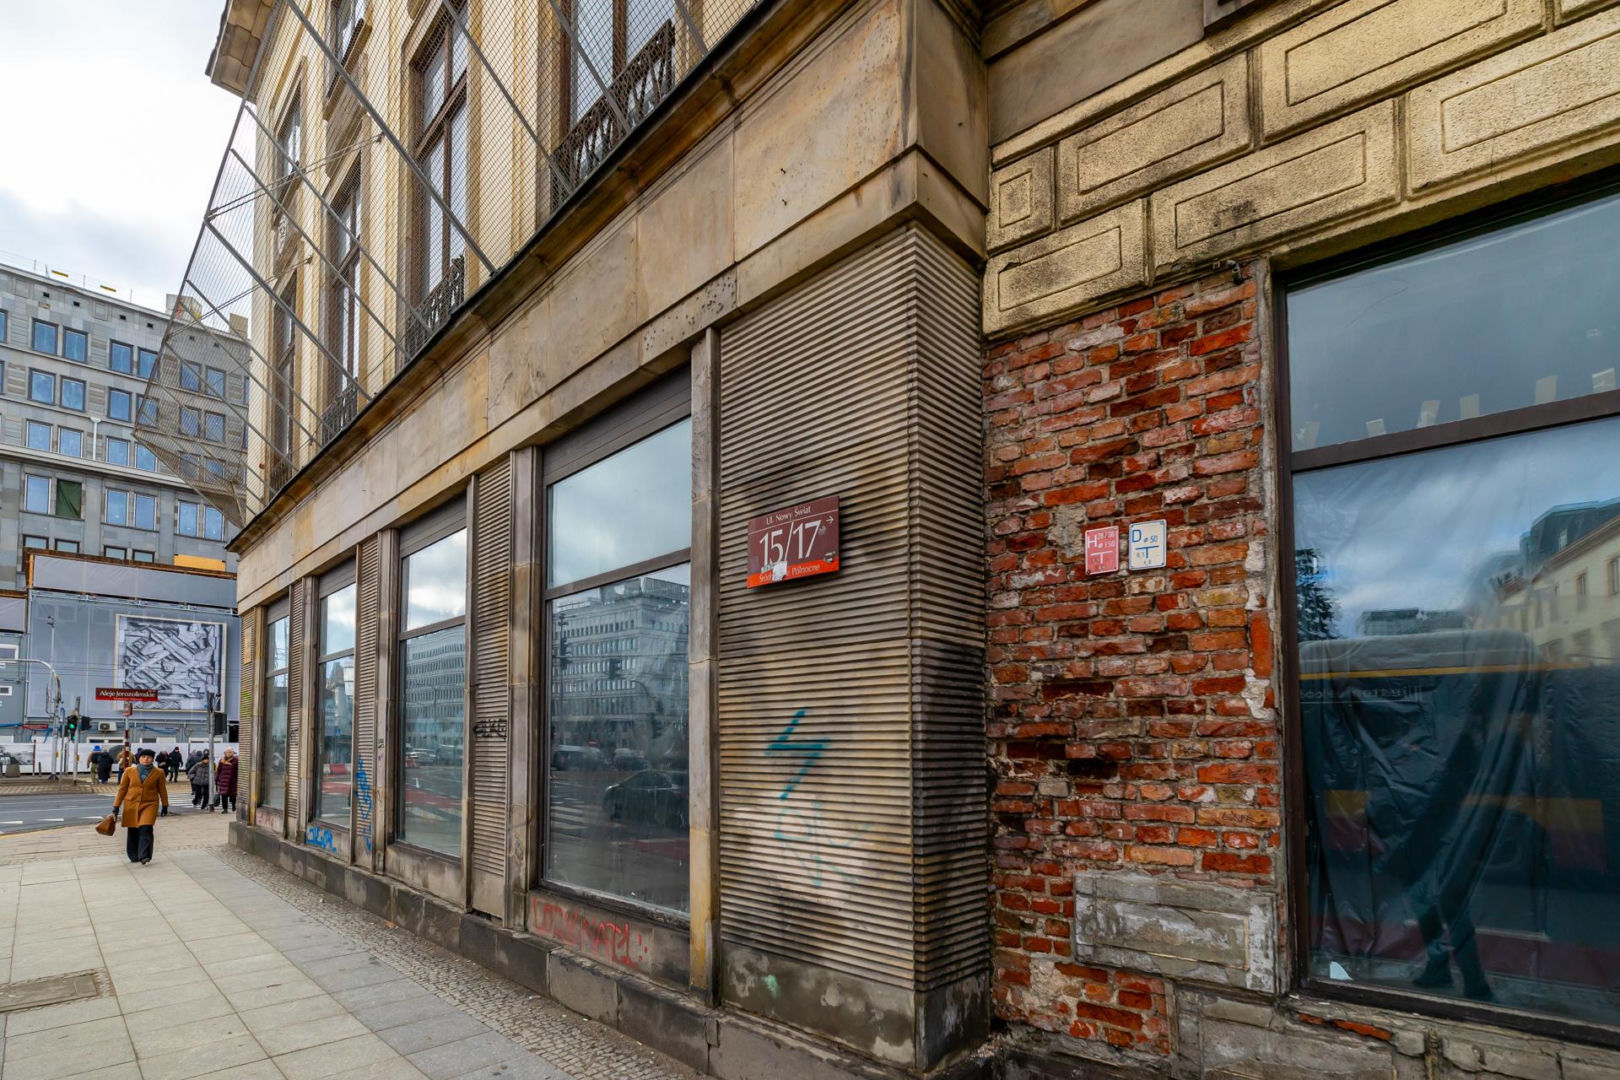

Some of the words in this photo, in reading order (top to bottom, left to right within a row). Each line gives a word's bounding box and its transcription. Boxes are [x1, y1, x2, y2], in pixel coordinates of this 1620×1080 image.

[776, 513, 792, 522] Nowy
[1087, 534, 1098, 548] H
[1132, 529, 1141, 543] D
[760, 520, 821, 567] 15/17
[100, 690, 116, 698] Aleje
